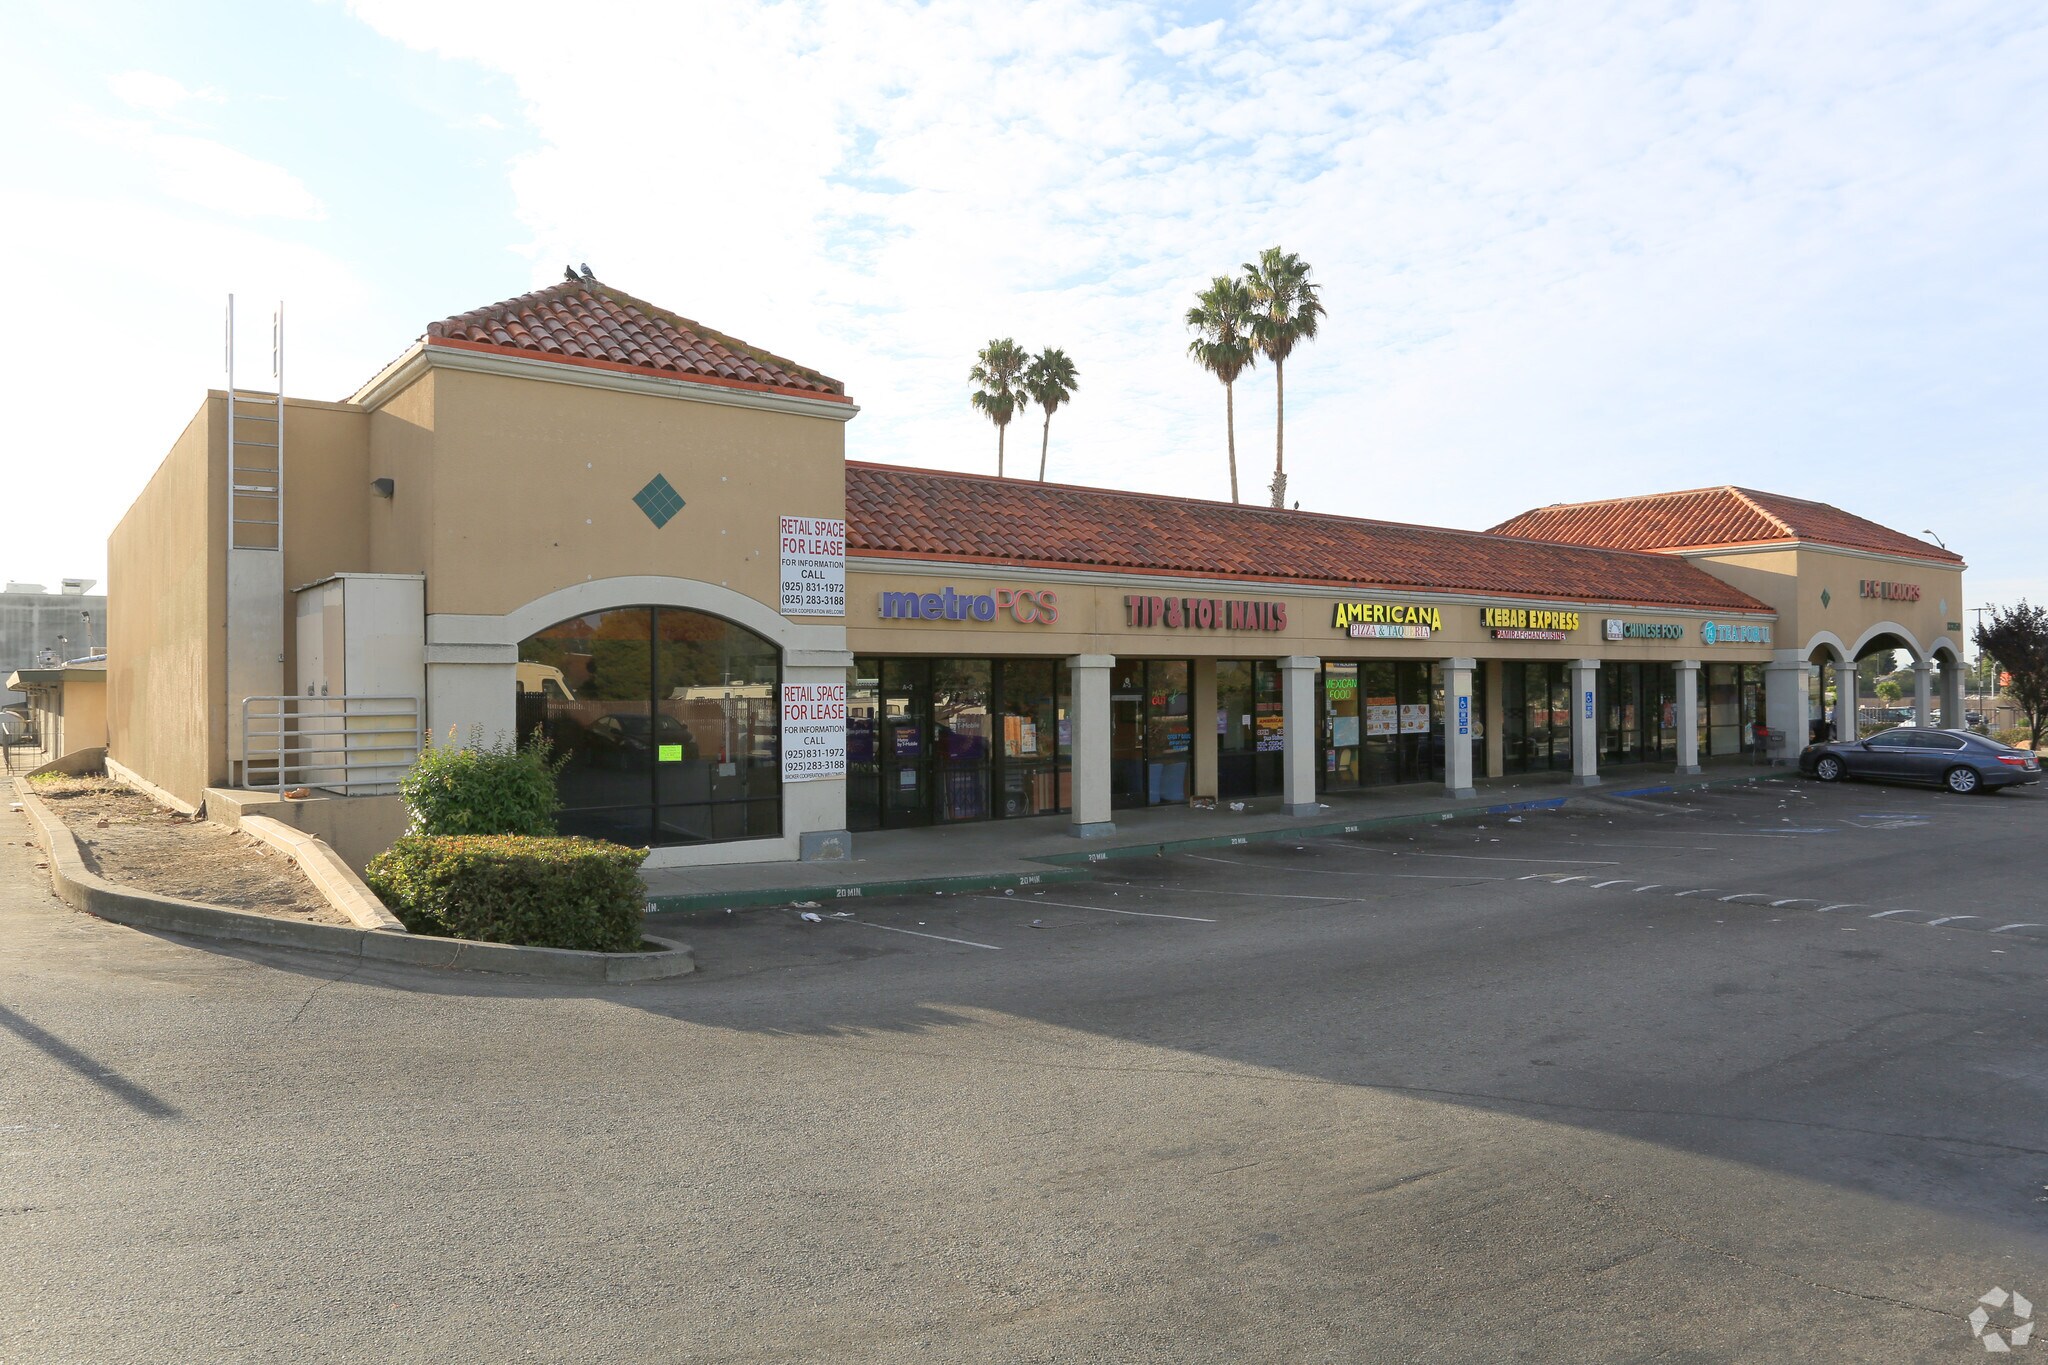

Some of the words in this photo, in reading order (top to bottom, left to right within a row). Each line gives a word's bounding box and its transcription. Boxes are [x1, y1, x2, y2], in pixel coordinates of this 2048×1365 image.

[781, 518, 812, 536] RETAIL
[814, 520, 844, 538] SPACE
[782, 537, 806, 554] FOR
[808, 539, 843, 556] LEASE
[781, 558, 797, 567] FOR
[797, 559, 844, 569] INFORMATION
[801, 569, 826, 580] CALL
[781, 581, 804, 593] (925)
[805, 582, 844, 593] 831-1972
[1885, 581, 1921, 602] LIQUORS
[781, 594, 804, 606] (925)
[805, 595, 844, 606] 283-3188
[880, 587, 1060, 626] metroPCS
[1127, 594, 1164, 627] TIP
[1165, 596, 1184, 629] &
[1185, 598, 1224, 630] TOE
[1229, 600, 1288, 632] NAILS
[1334, 602, 1442, 632] AMERICANA
[1484, 607, 1527, 628] KEBAB
[1529, 609, 1580, 631] EXPRESS
[1351, 623, 1377, 636] PIZZA
[1378, 627, 1385, 636] &
[1387, 625, 1429, 638] TAQUERIA
[1623, 622, 1661, 639] CHINESE
[1661, 624, 1685, 639] FOOD
[1717, 624, 1740, 642] TEA
[1740, 625, 1761, 643] FOR
[1325, 678, 1358, 689] MEXICAN
[784, 686, 815, 702] RETAIL
[816, 685, 844, 702] SPACE
[1329, 689, 1352, 700] FOOD
[784, 704, 808, 721] FOR
[810, 703, 845, 720] LEASE
[784, 726, 799, 734] FOR
[799, 725, 845, 734] INFORMATION
[803, 736, 826, 745] CALL
[784, 749, 806, 760] (925)
[806, 748, 845, 759] 831-1972
[784, 761, 806, 772] (925)
[806, 760, 845, 771] 283-3188
[1020, 876, 1029, 885] 20
[836, 888, 847, 898] 20
